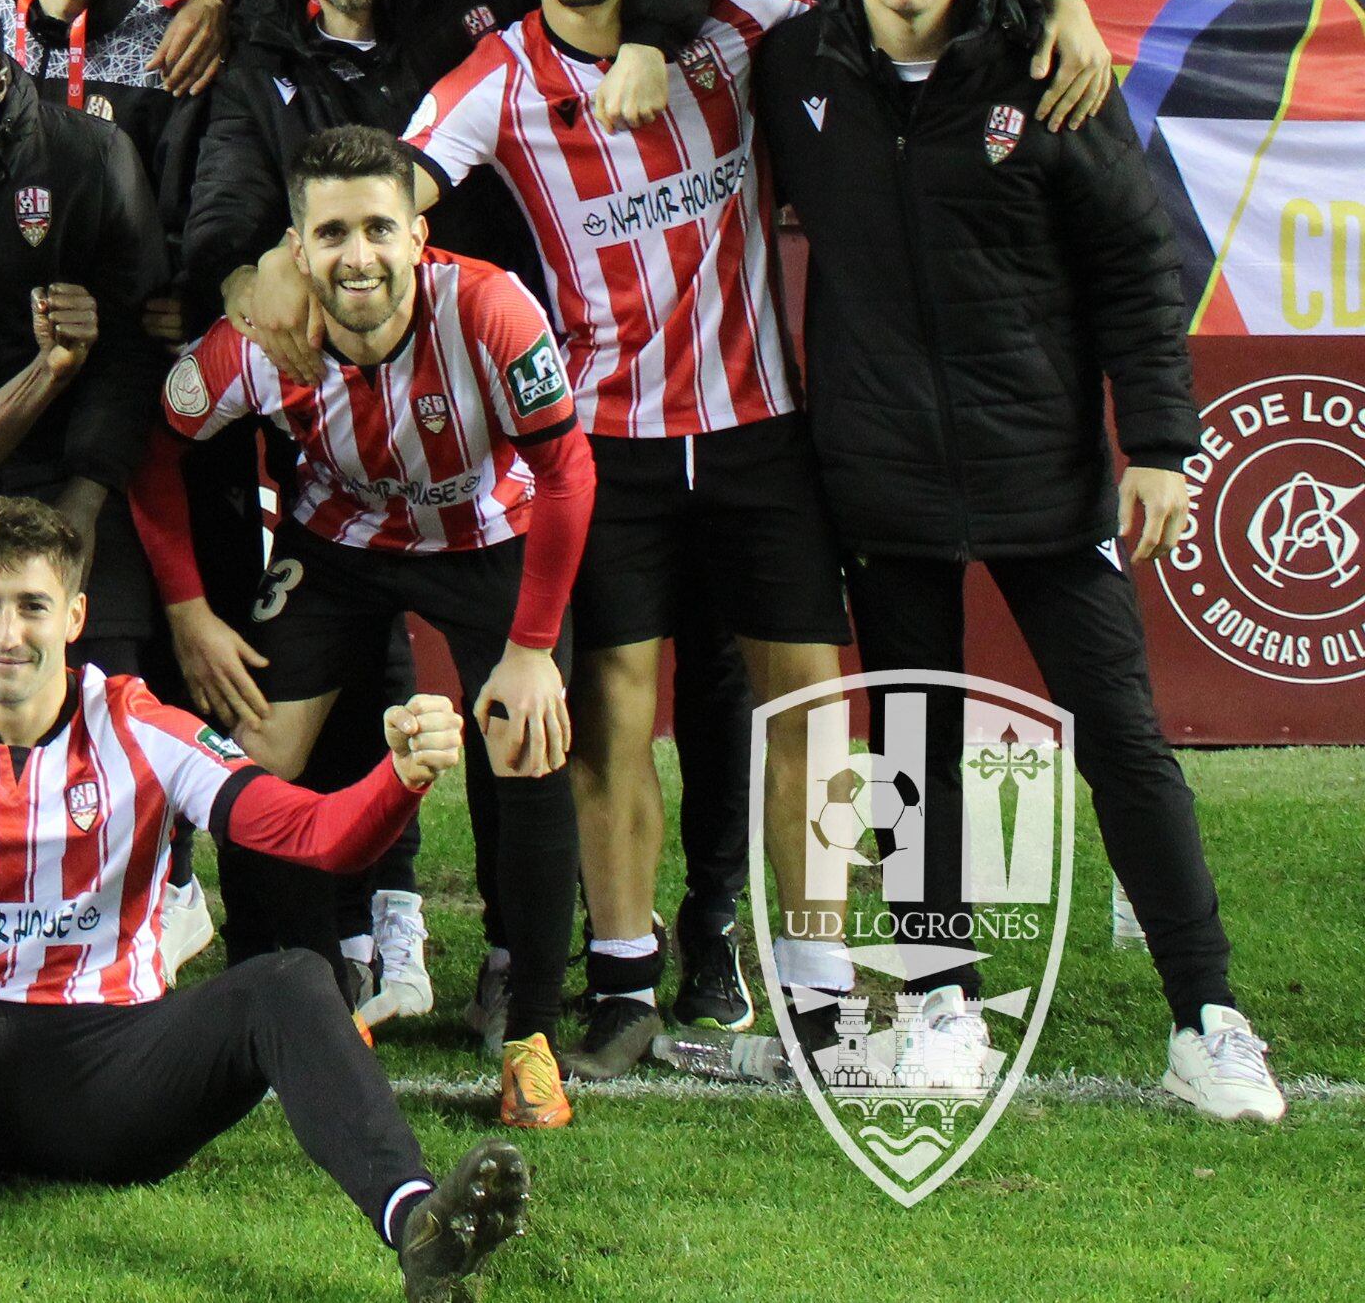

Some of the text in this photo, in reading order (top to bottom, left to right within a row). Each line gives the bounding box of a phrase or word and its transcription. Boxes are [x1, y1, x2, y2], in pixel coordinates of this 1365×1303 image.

[607, 160, 735, 238] NATUR HOUSE
[513, 346, 557, 394] LR
[1229, 392, 1290, 438] DE
[1201, 598, 1311, 668] BODEGAS
